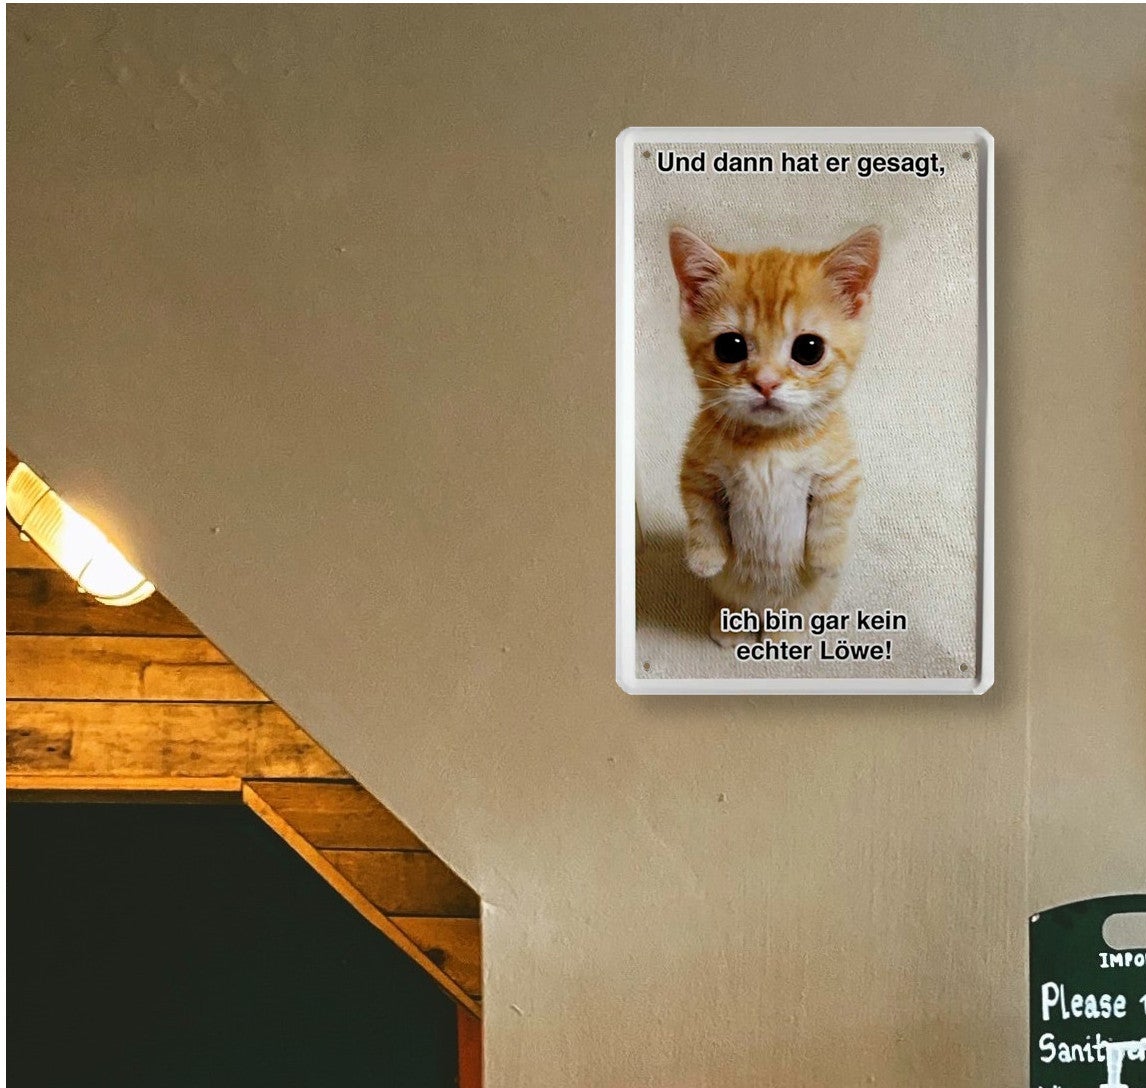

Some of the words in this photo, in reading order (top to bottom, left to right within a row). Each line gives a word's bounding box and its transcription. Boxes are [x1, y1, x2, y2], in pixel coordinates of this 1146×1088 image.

[657, 152, 705, 172] Und
[713, 152, 773, 172] dann
[781, 152, 818, 172] hat
[826, 157, 850, 172] er
[857, 153, 945, 177] gesagt,
[723, 611, 758, 630] ich
[766, 611, 802, 630] bin
[811, 614, 849, 634] gar
[857, 611, 906, 630] kein
[737, 641, 812, 660] echter
[821, 641, 891, 660] Löwe!
[1041, 982, 1127, 1021] Please
[1039, 1033, 1146, 1063] Saniter
